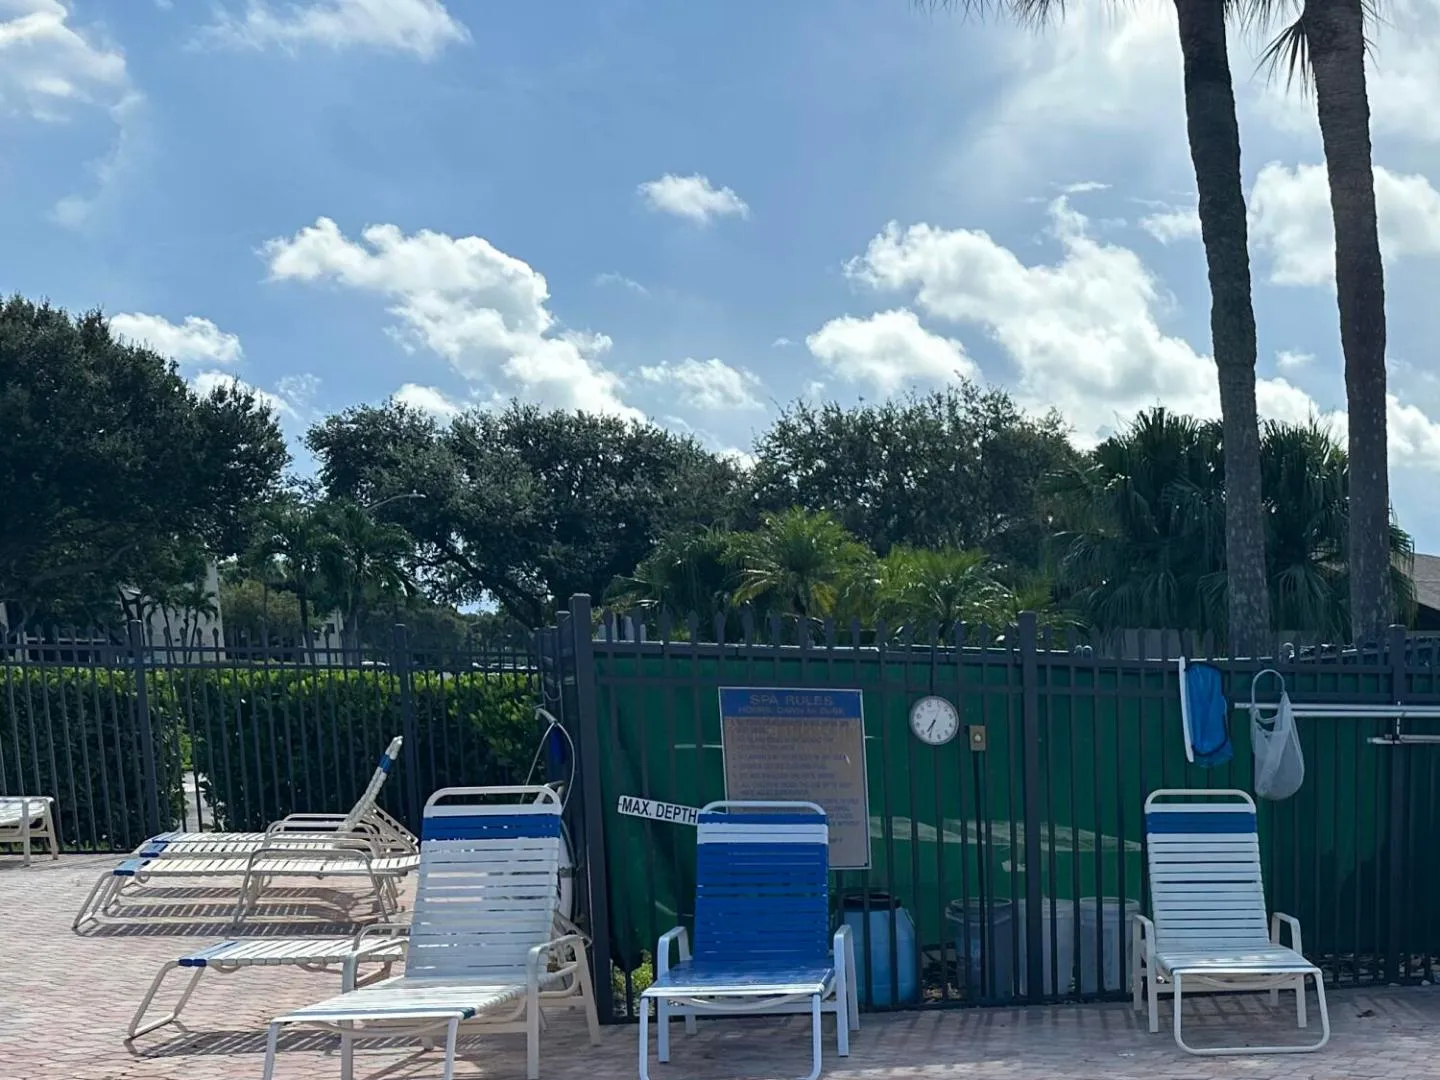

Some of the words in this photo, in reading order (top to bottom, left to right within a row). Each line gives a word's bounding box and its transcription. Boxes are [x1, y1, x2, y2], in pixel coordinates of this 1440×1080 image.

[749, 694, 778, 706] SPA
[785, 694, 833, 706] RULES
[621, 797, 652, 816] MAX.
[656, 803, 697, 823] DEPTH
